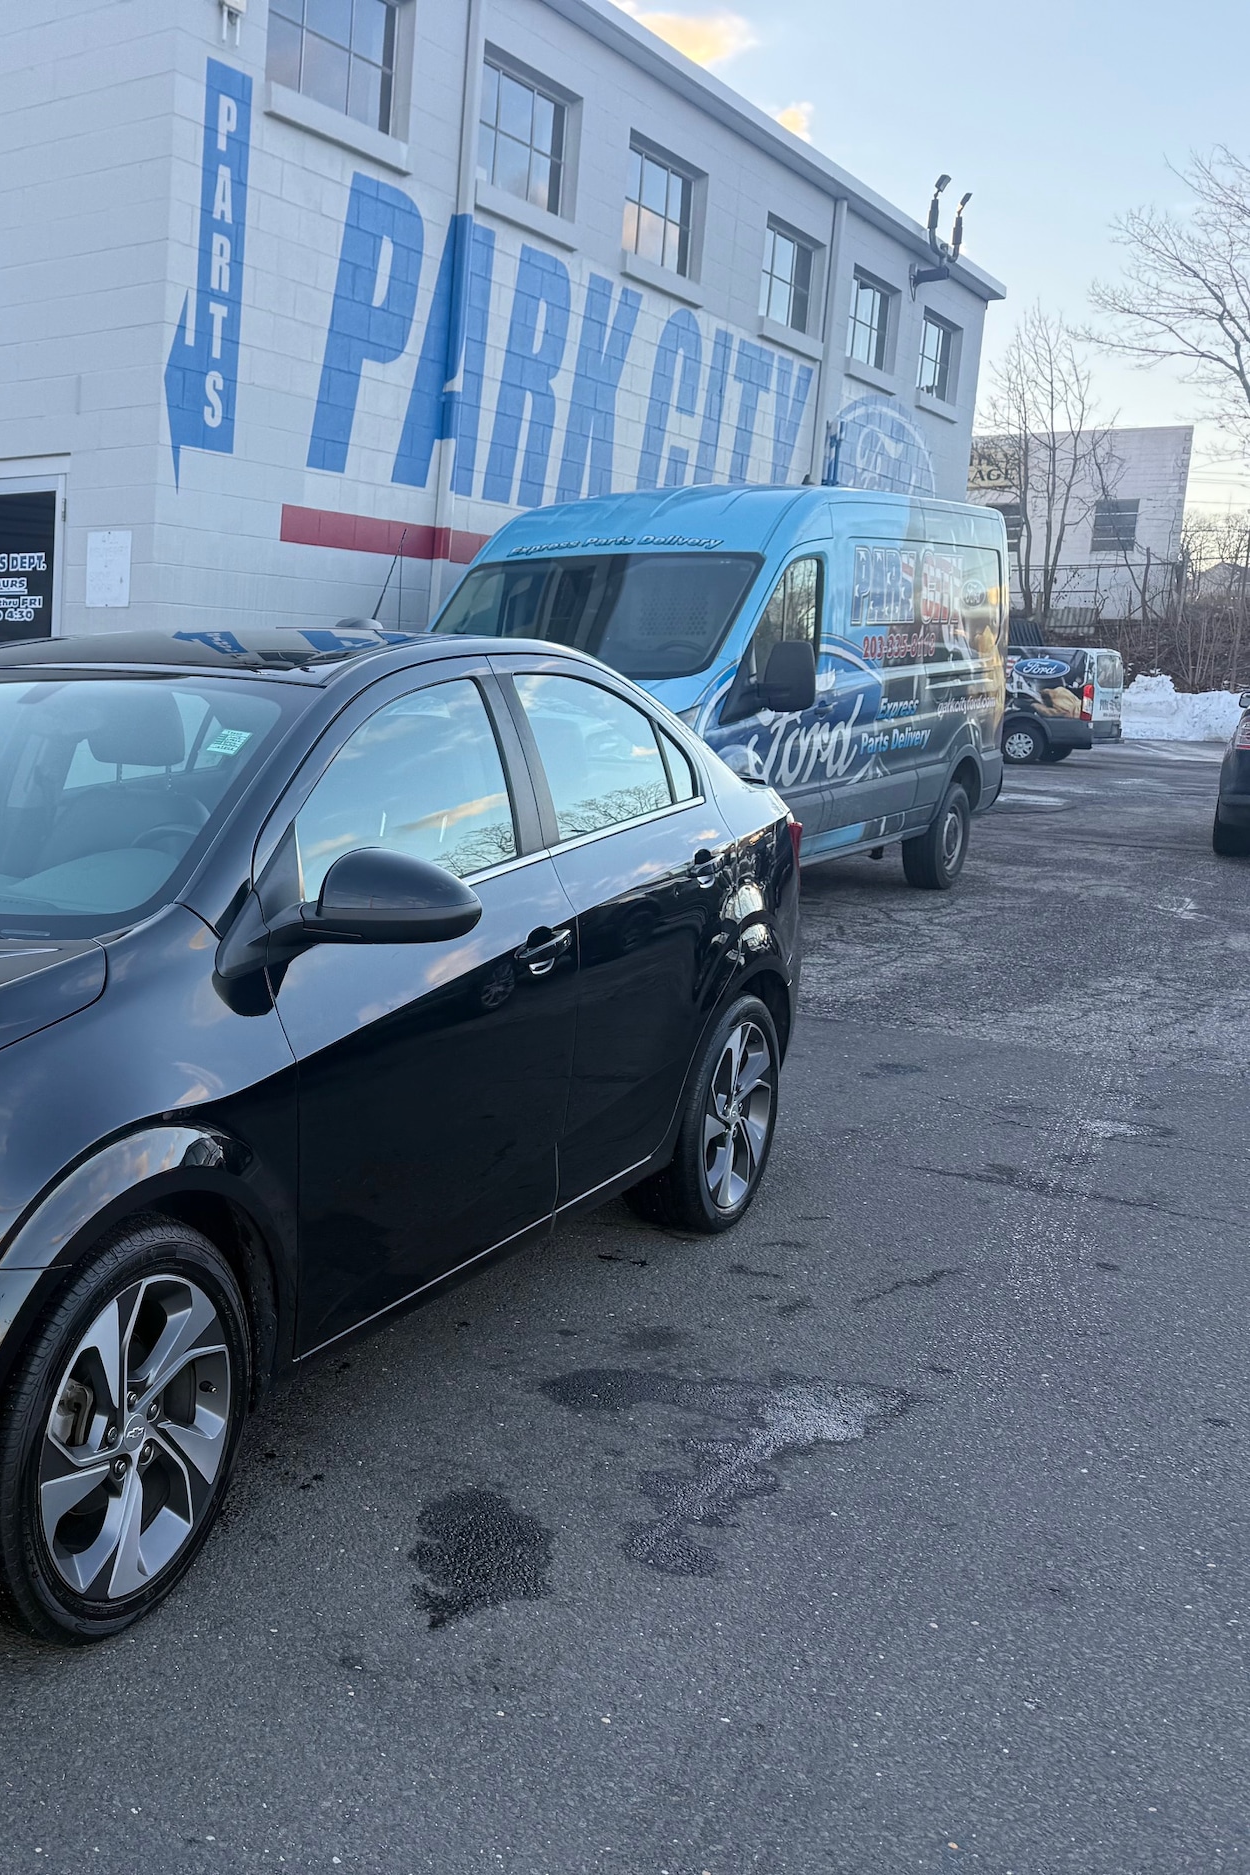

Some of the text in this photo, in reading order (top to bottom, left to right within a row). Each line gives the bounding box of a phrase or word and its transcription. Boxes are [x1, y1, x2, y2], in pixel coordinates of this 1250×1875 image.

[203, 94, 238, 429] PARTS
[306, 171, 814, 510] PARK CITY
[507, 535, 724, 557] Express Parts Delivery
[9, 552, 48, 571] DEPT.
[851, 545, 964, 626] PARK CITY
[20, 596, 43, 608] FRI
[6, 609, 34, 621] 4:30
[1022, 660, 1056, 675] Ford
[875, 697, 919, 720] Express
[747, 693, 865, 787] Ford
[860, 727, 931, 755] Parts Delivery
